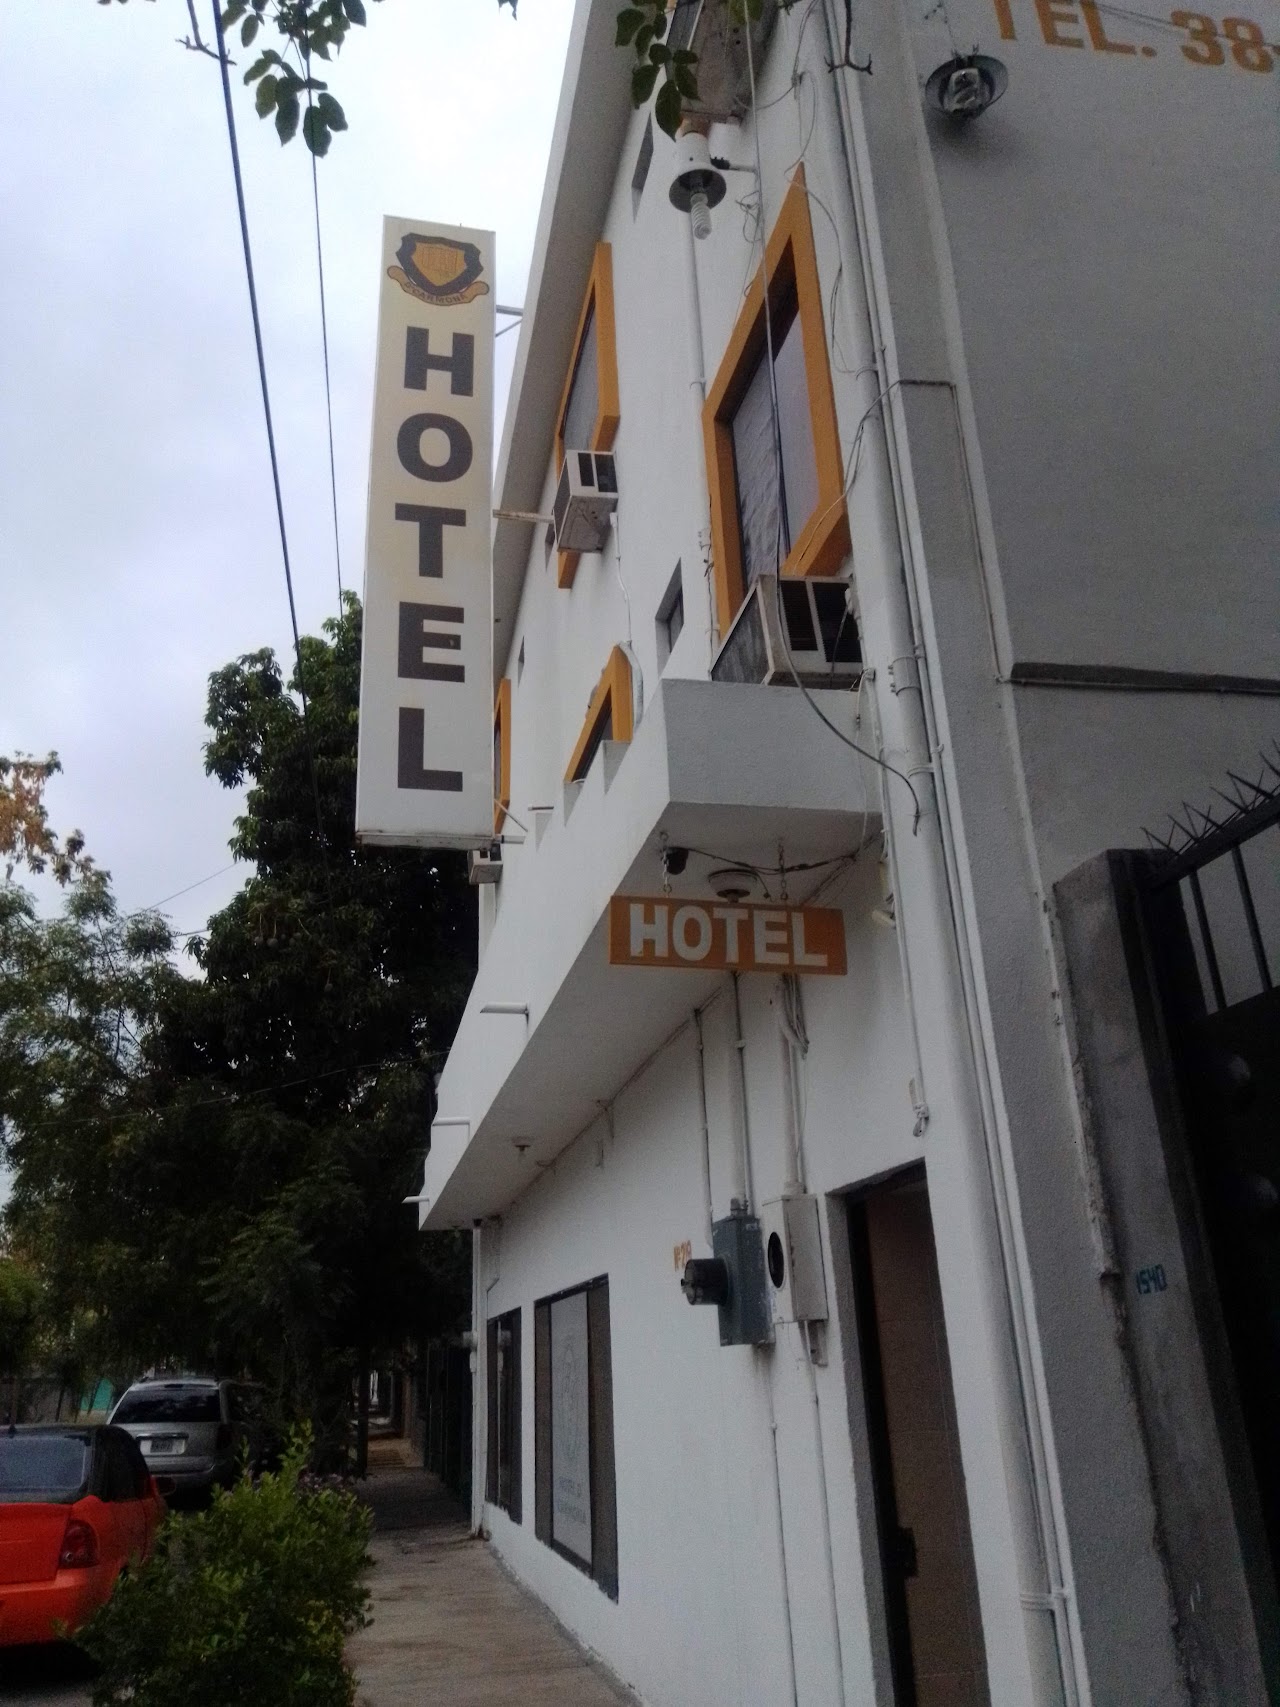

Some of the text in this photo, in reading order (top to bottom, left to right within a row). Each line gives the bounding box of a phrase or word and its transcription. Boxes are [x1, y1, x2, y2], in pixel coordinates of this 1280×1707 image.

[1171, 10, 1280, 73] 38
[395, 325, 475, 792] HOTEL
[629, 902, 828, 967] HOTEL
